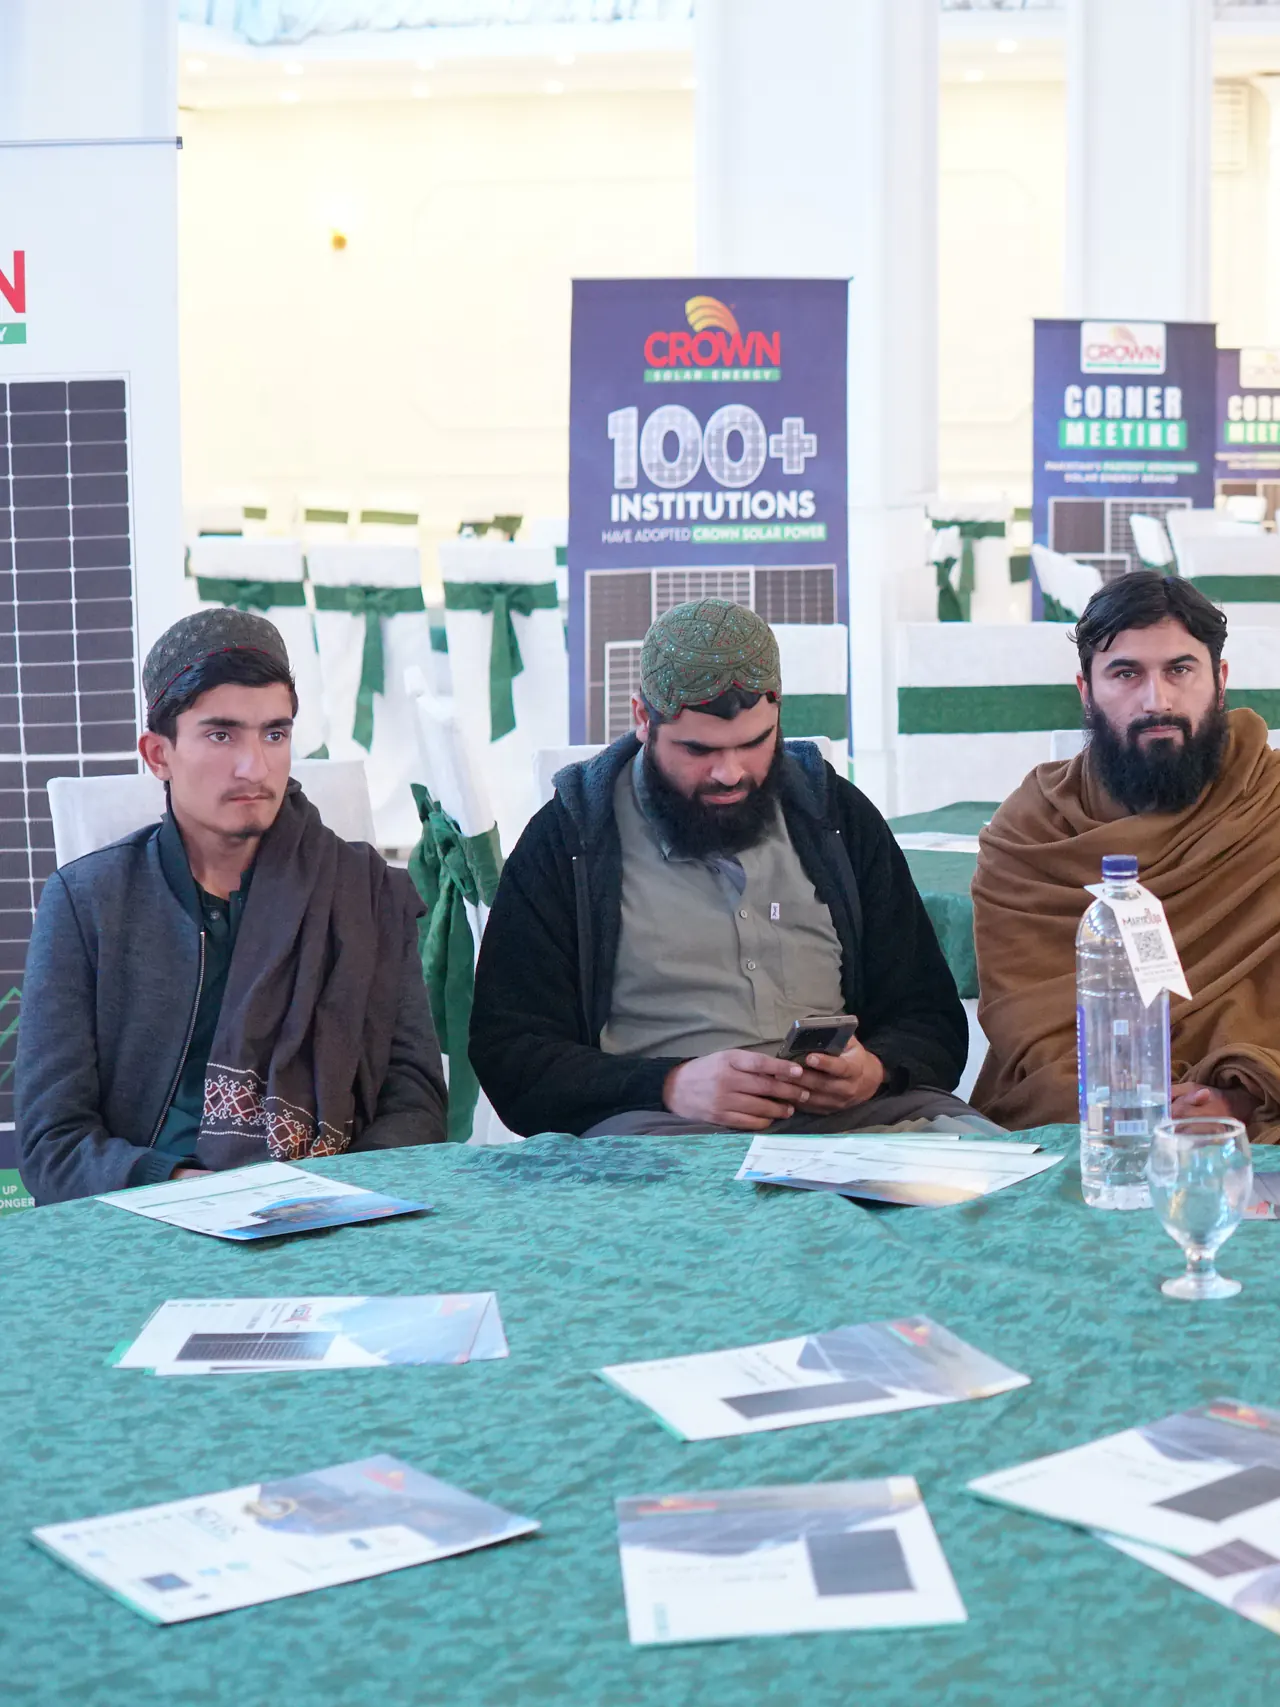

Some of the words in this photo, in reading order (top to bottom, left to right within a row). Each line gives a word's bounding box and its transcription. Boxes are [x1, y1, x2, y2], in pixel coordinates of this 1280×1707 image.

[643, 331, 781, 367] CROWN
[1064, 385, 1183, 419] CORNER
[607, 403, 818, 489] 100+
[1065, 421, 1181, 447] MEETING
[610, 490, 817, 522] INSTITUTIONS
[601, 528, 632, 543] HAVE
[634, 527, 691, 543] ADOPTED
[693, 526, 740, 541] CROWN
[743, 525, 781, 540] SOLAR
[784, 524, 825, 540] POWER
[2, 1185, 18, 1195] UP
